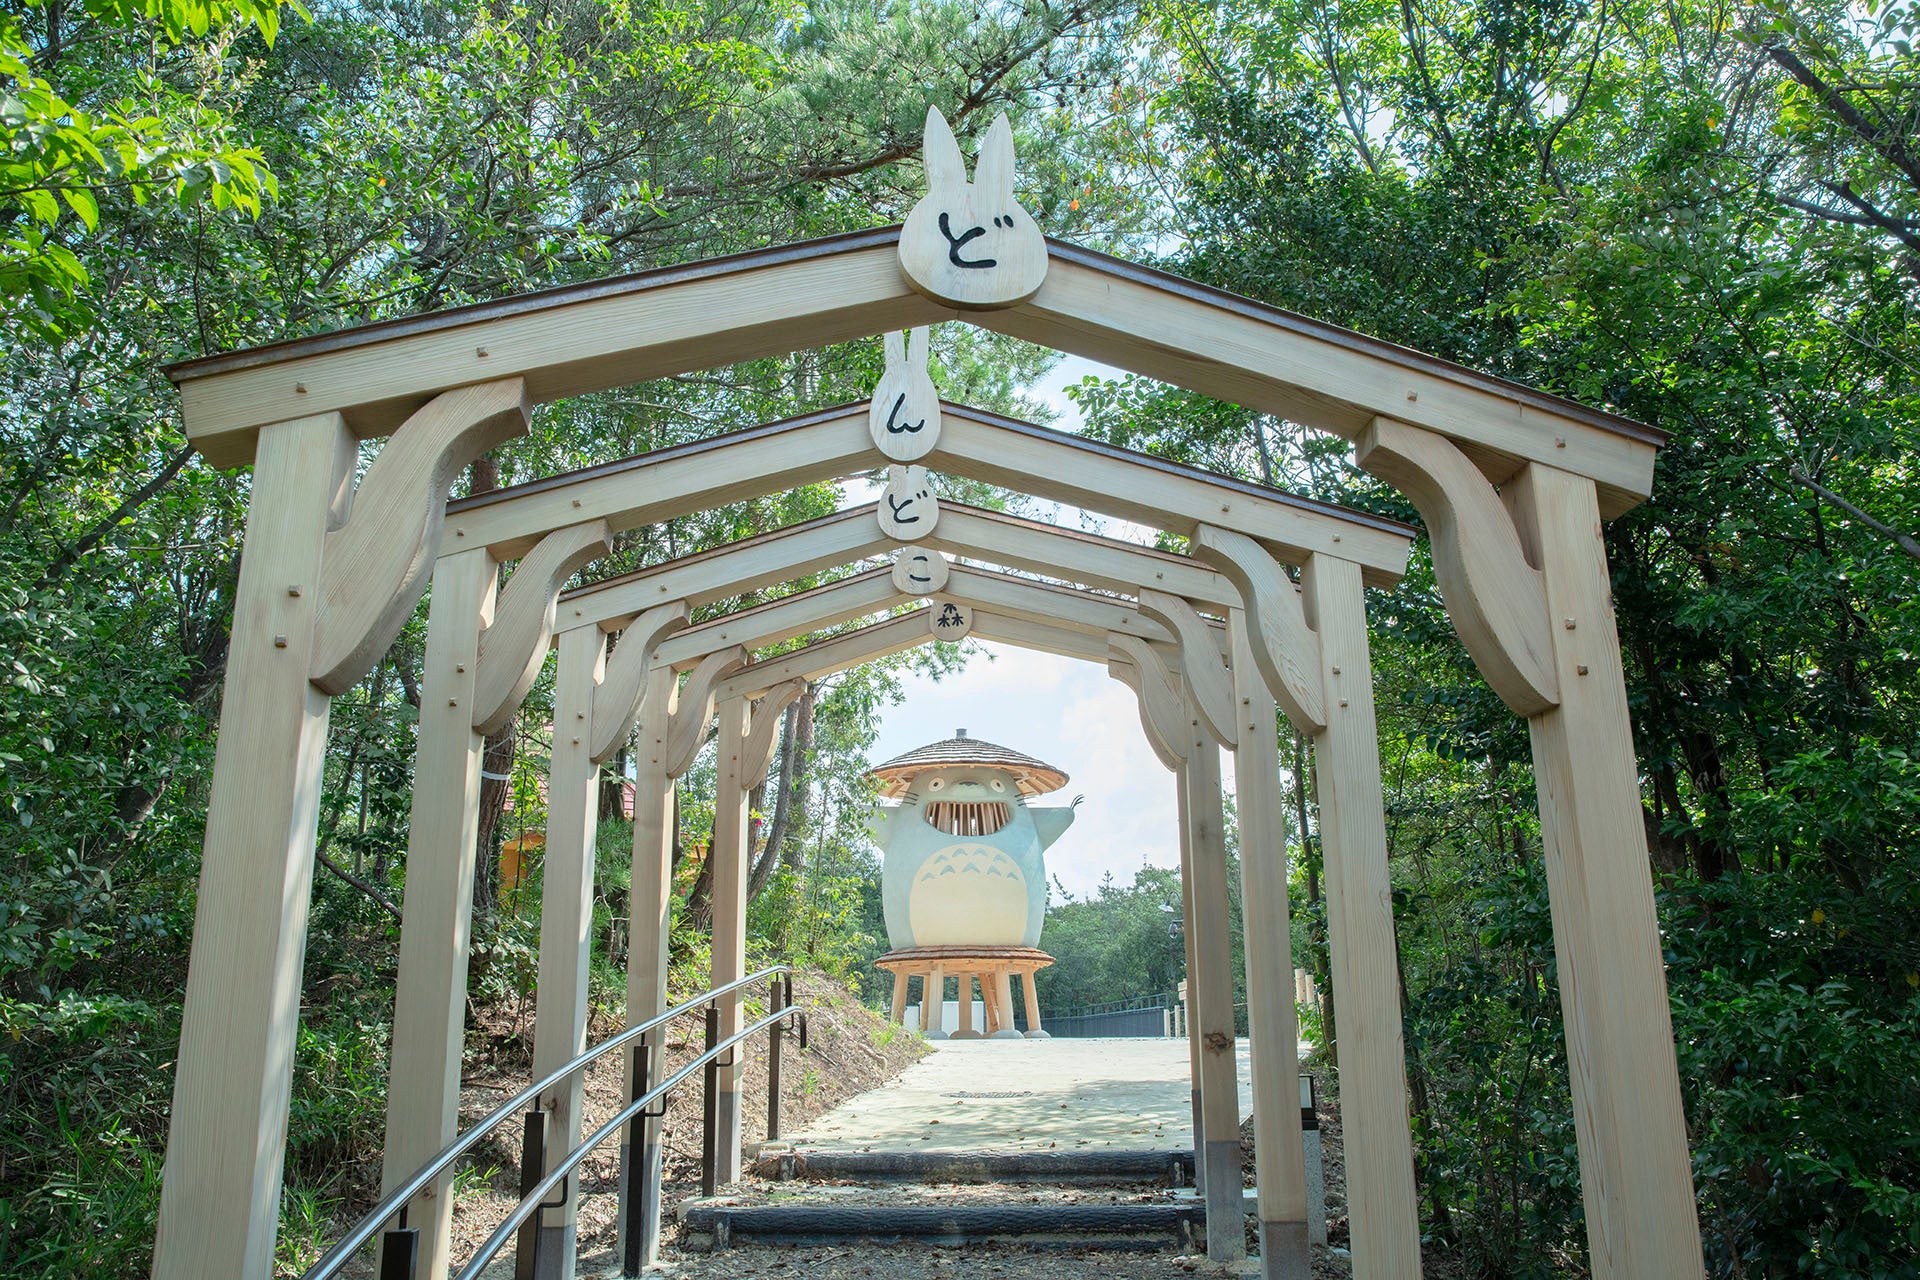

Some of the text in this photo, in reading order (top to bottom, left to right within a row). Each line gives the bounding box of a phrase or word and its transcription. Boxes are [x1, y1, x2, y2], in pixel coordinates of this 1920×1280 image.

[939, 212, 1014, 268] ど
[887, 393, 925, 434] ん
[888, 490, 928, 523] ど
[910, 555, 931, 581] こ
[937, 603, 964, 628] 森
